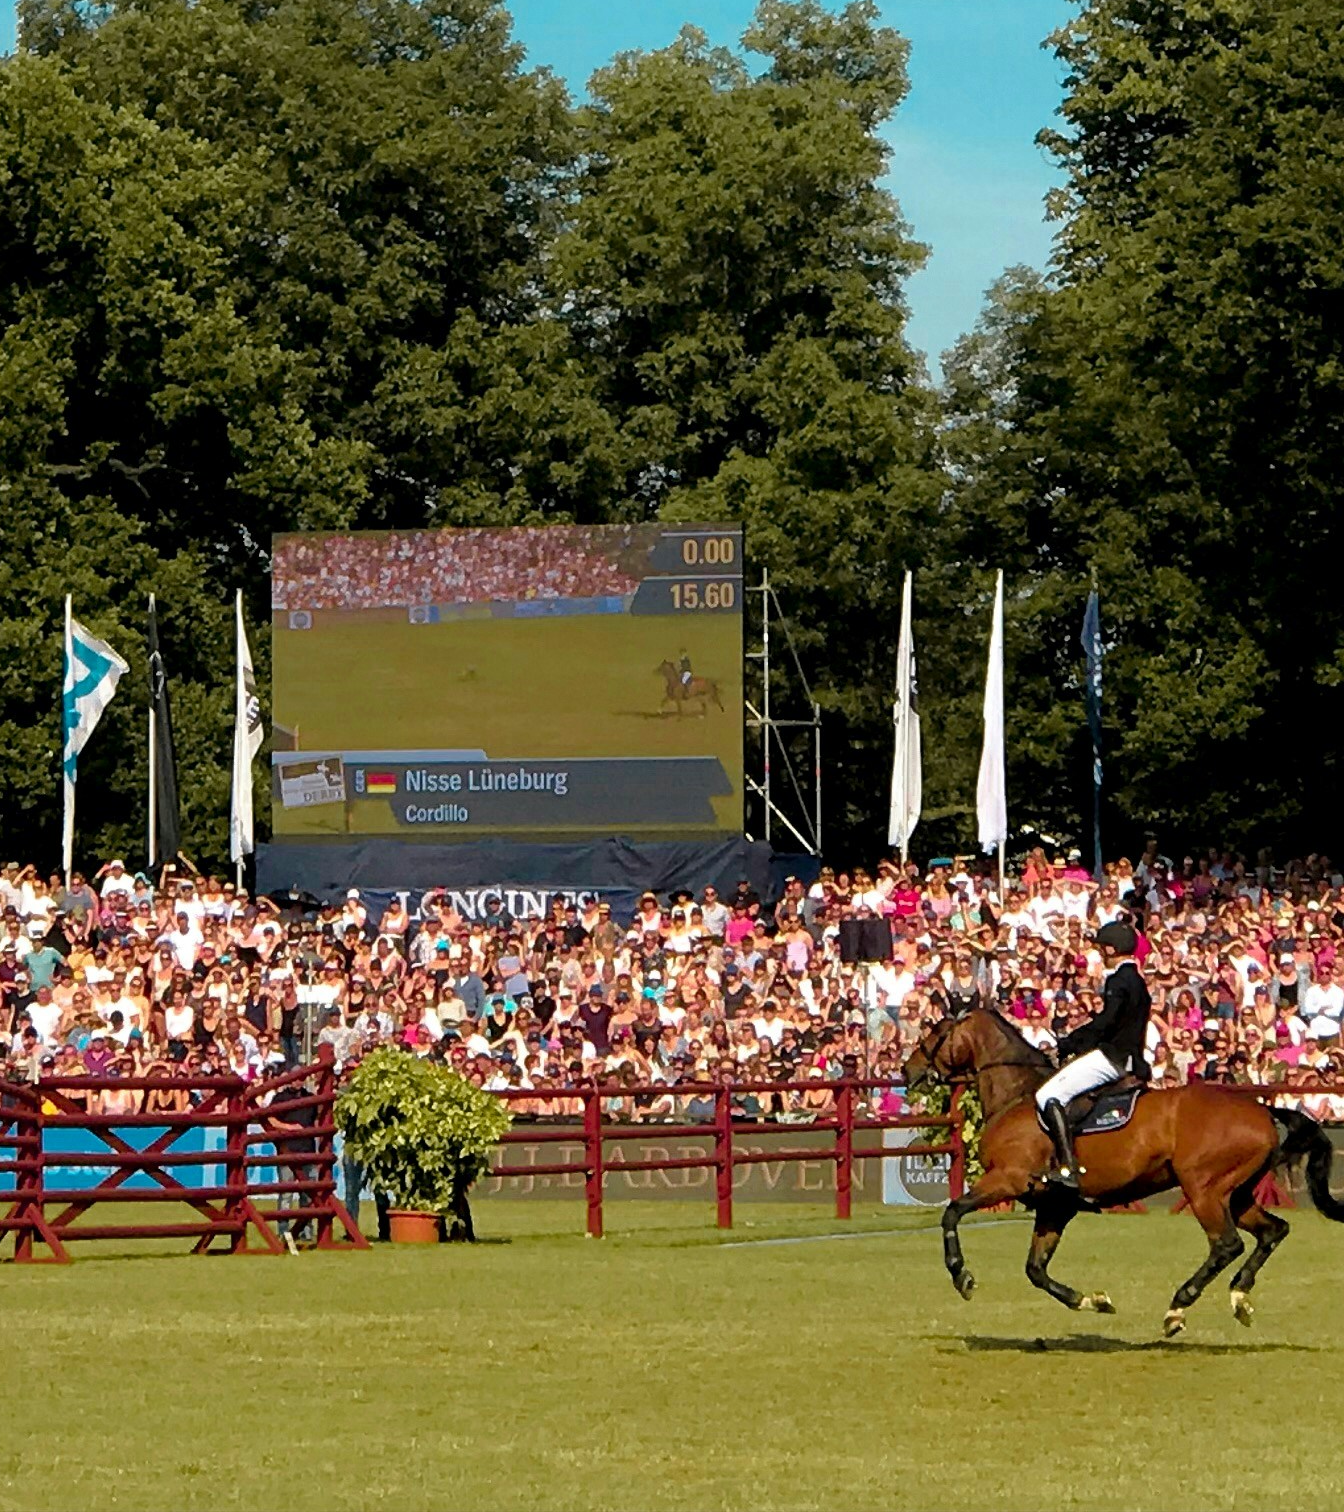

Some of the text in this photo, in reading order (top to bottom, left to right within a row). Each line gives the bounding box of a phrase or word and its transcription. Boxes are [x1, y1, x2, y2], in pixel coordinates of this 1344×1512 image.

[683, 538, 735, 566] 0.00
[669, 582, 735, 608] 15.60
[406, 769, 569, 795] Nisse Lüneburg
[406, 804, 468, 822] Cordillo
